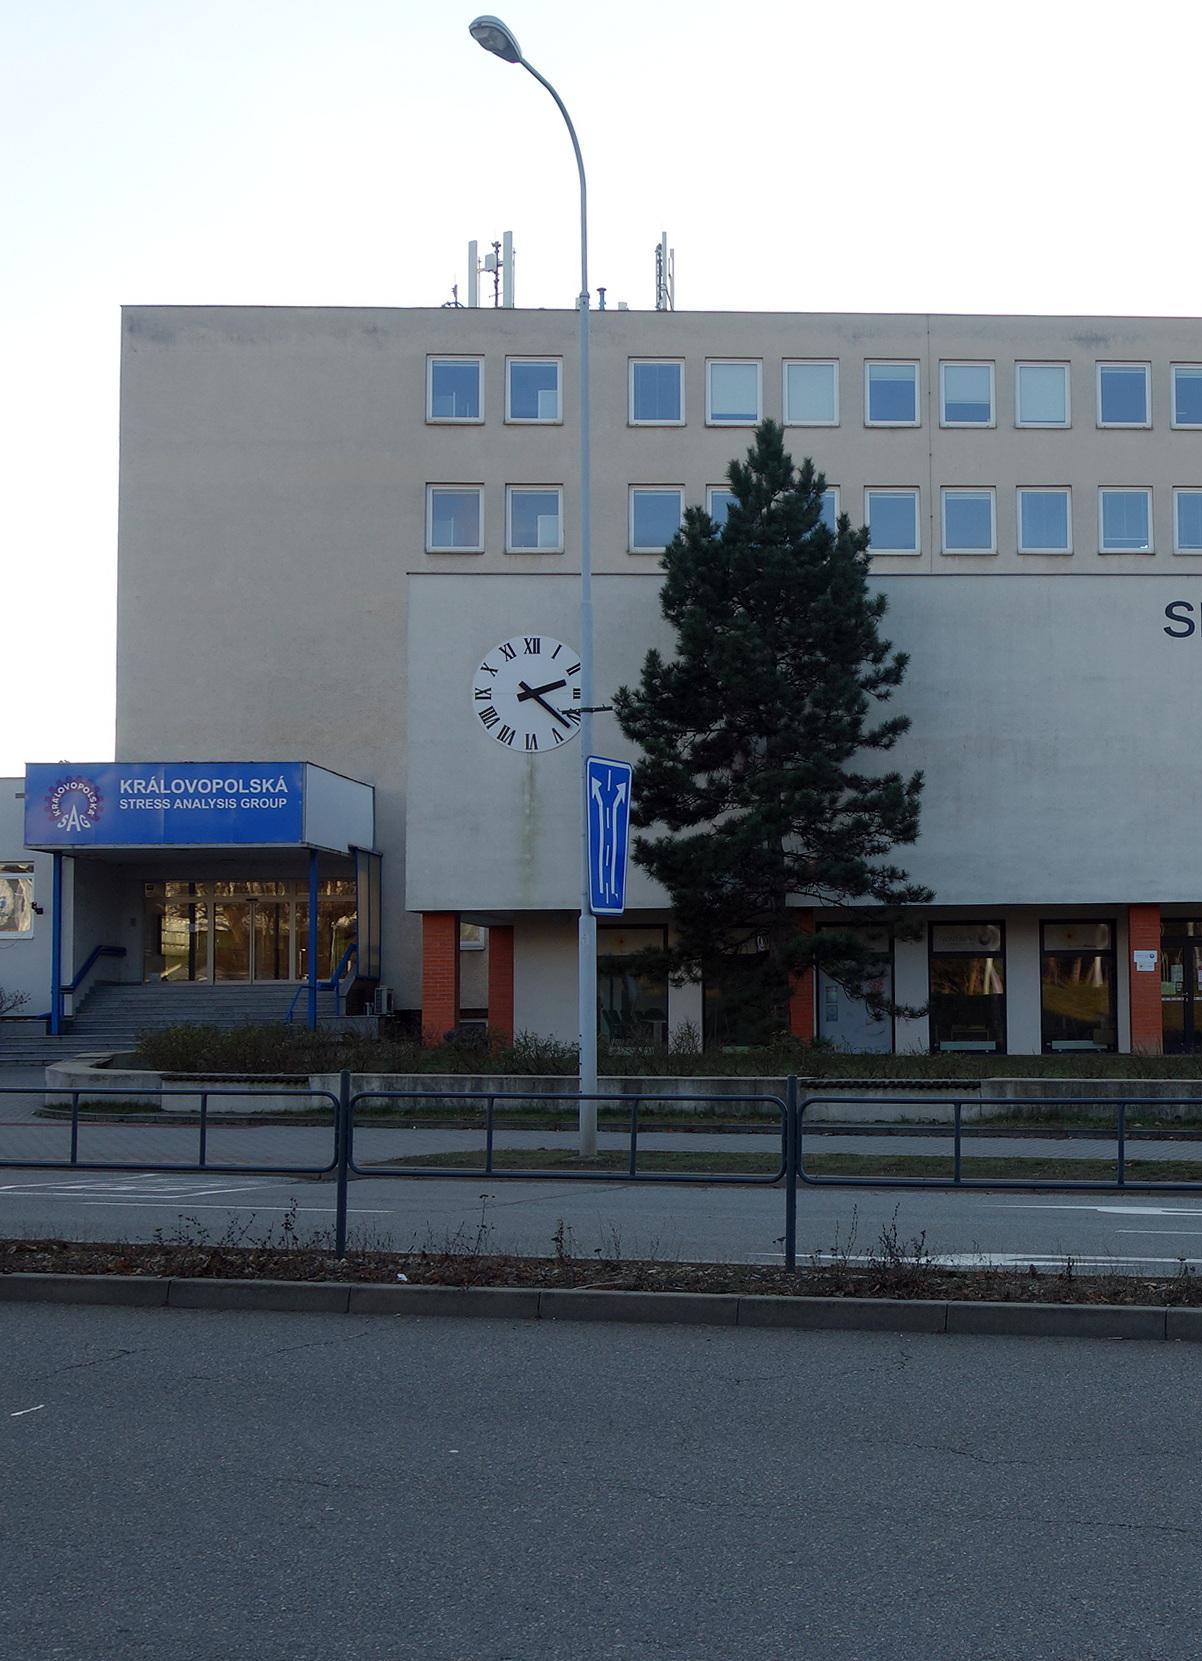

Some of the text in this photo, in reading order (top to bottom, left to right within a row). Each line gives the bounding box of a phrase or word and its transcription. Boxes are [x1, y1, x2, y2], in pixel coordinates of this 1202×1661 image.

[499, 643, 516, 661] XI
[523, 637, 541, 655] XII
[480, 662, 498, 677] X
[474, 687, 492, 700] IX
[496, 724, 516, 746] VII
[525, 733, 539, 750] VI
[551, 727, 565, 744] V
[119, 776, 289, 794] KRÁLOVOPOLSKÁ
[119, 798, 288, 810] STRESS ANALYSIS GROUP
[56, 804, 92, 832] SAG
